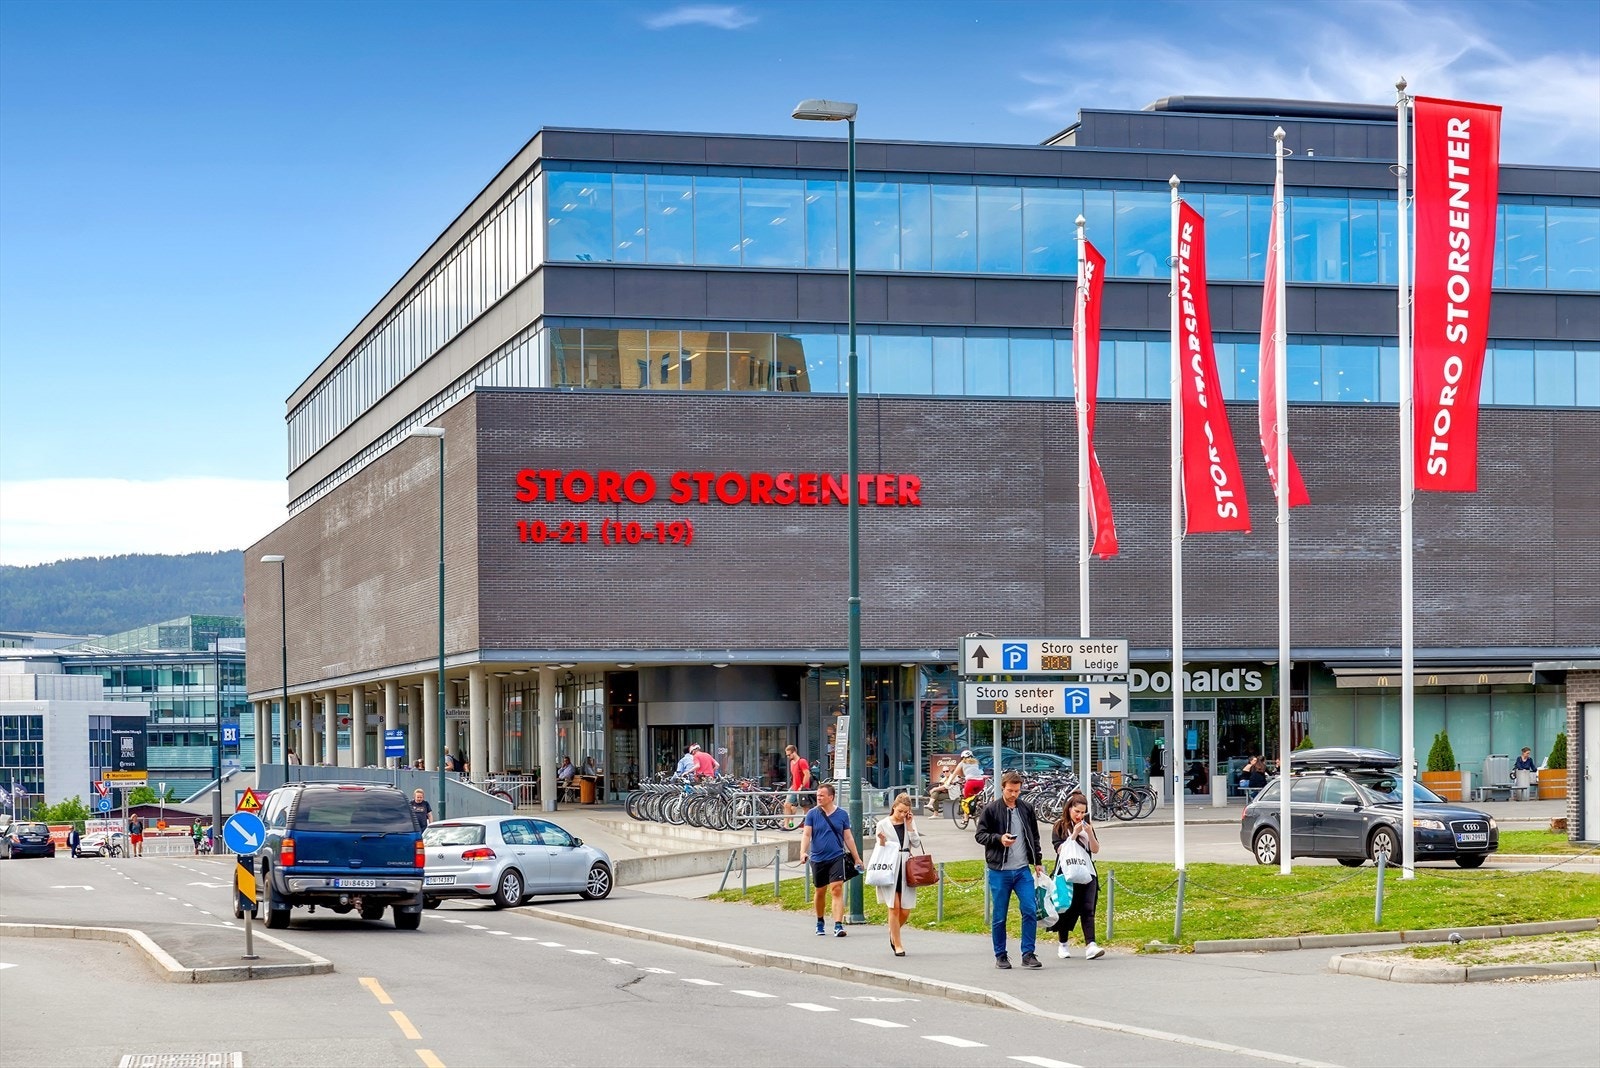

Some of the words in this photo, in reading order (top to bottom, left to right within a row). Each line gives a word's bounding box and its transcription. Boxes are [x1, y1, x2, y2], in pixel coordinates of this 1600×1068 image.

[1427, 355, 1463, 477] STORO
[1446, 117, 1470, 345] STORSENTER
[515, 469, 657, 504] STORO
[669, 471, 922, 506] STORSENTER
[516, 519, 590, 544] 10-21
[601, 518, 694, 547] (10-19)
[1041, 642, 1073, 654] Storo
[1079, 642, 1119, 654] senter
[1041, 655, 1070, 670] 303
[1084, 659, 1119, 671] Ledige
[1090, 668, 1262, 692] Donald's
[976, 686, 1009, 698] Storo
[1014, 687, 1054, 698] senter
[1020, 703, 1055, 715] Ledige
[223, 728, 237, 741] BI
[340, 879, 349, 887] JU
[352, 879, 375, 887] 84639
